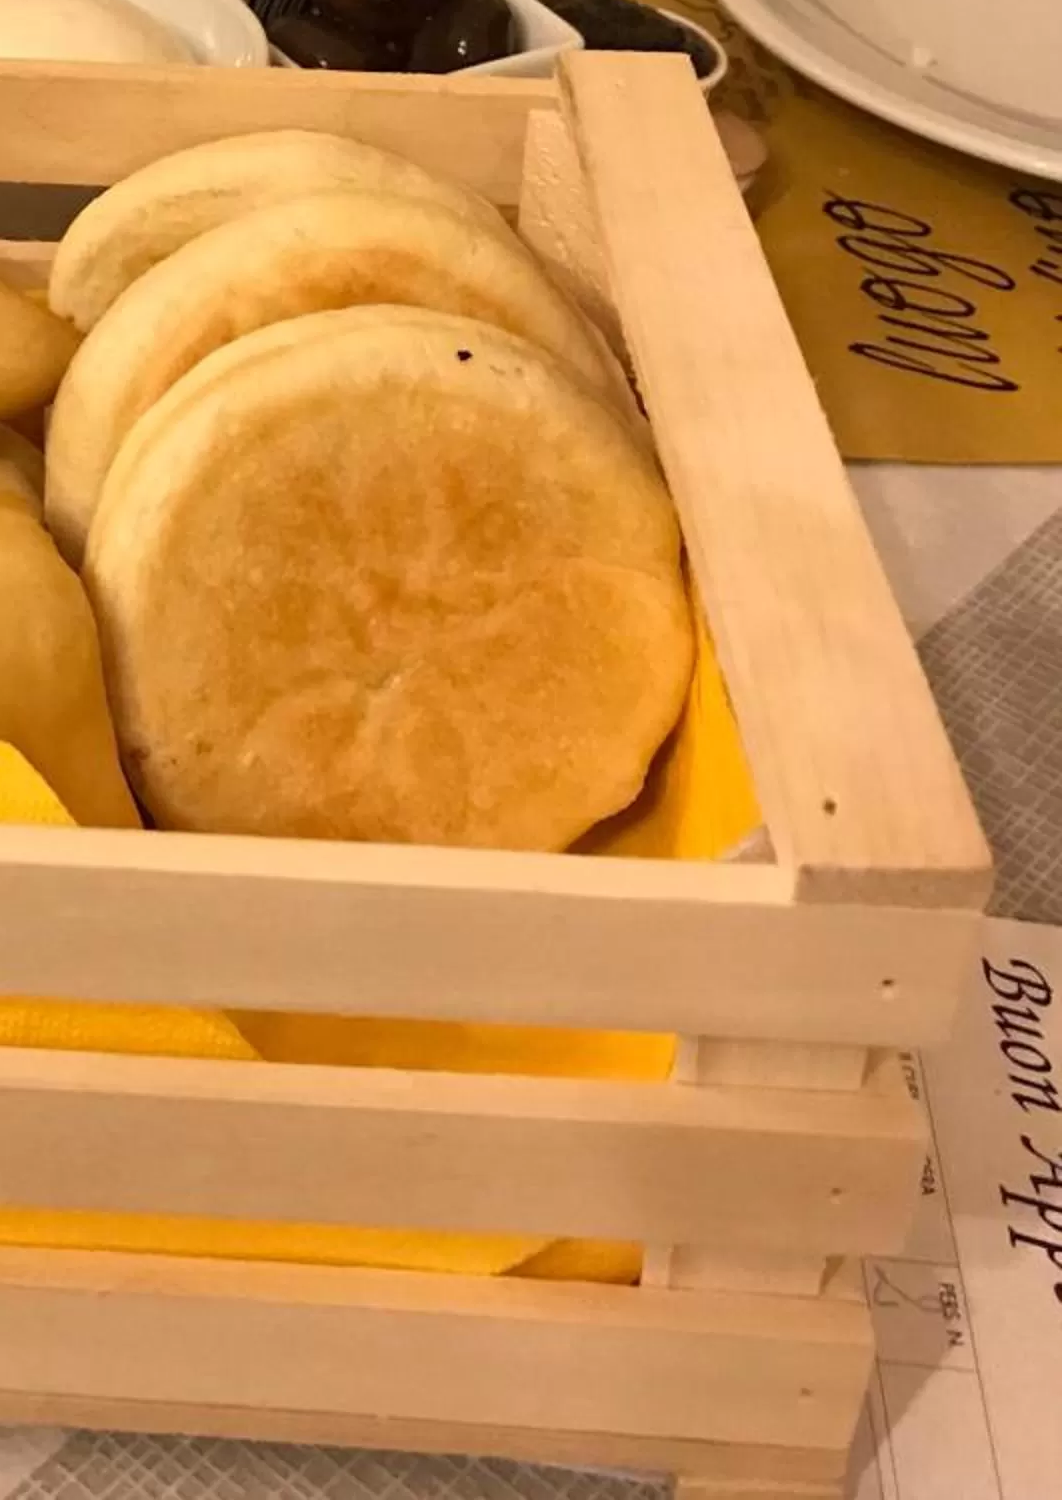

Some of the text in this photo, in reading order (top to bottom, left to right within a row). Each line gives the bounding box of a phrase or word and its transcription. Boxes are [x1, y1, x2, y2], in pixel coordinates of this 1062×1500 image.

[822, 187, 1020, 392] luogo
[981, 956, 1062, 1304] Buon App
